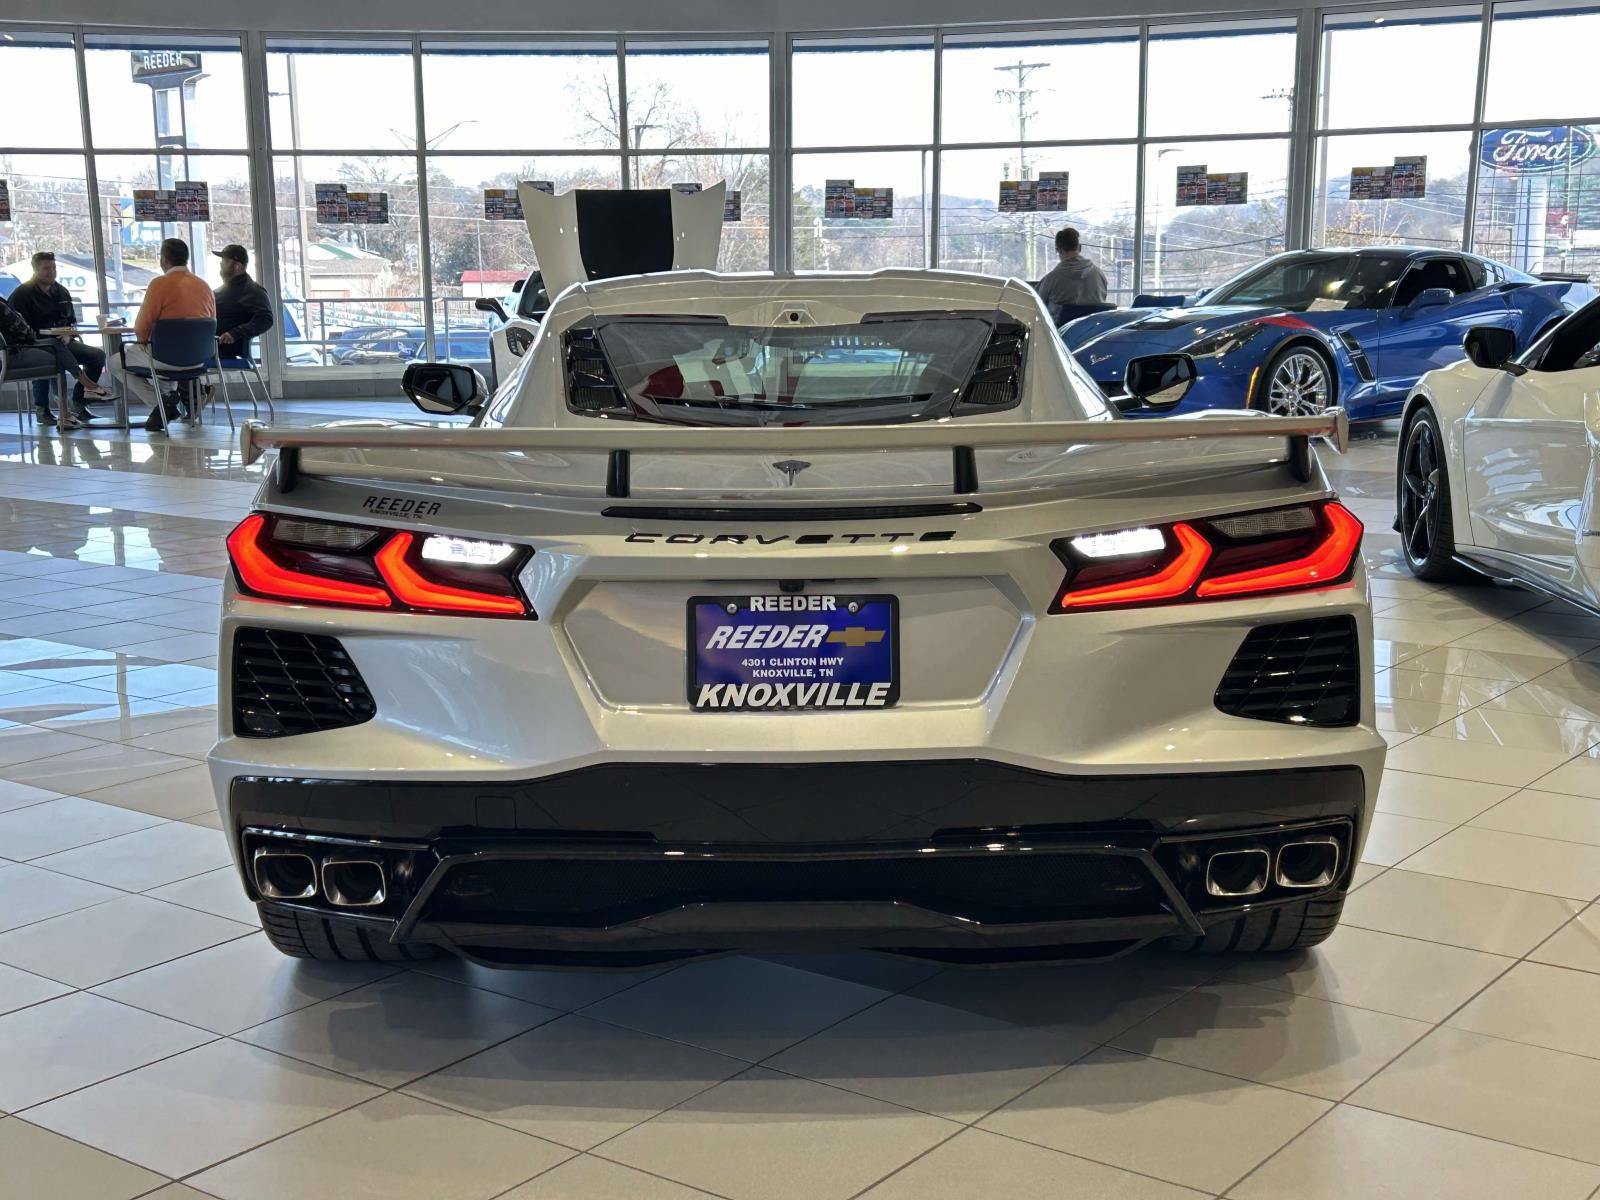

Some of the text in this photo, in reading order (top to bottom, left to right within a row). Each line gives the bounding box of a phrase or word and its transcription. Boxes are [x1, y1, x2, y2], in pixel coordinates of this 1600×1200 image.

[1493, 130, 1568, 162] Ford
[363, 496, 442, 515] REEDER
[625, 530, 957, 545] CORVETTE
[750, 596, 836, 611] REEDER
[705, 625, 829, 649] REEDER
[741, 657, 844, 667] 4301 CLINTON HWY
[752, 668, 834, 678] KNOXVILLE, TN
[696, 682, 891, 708] KNOXVILLE
